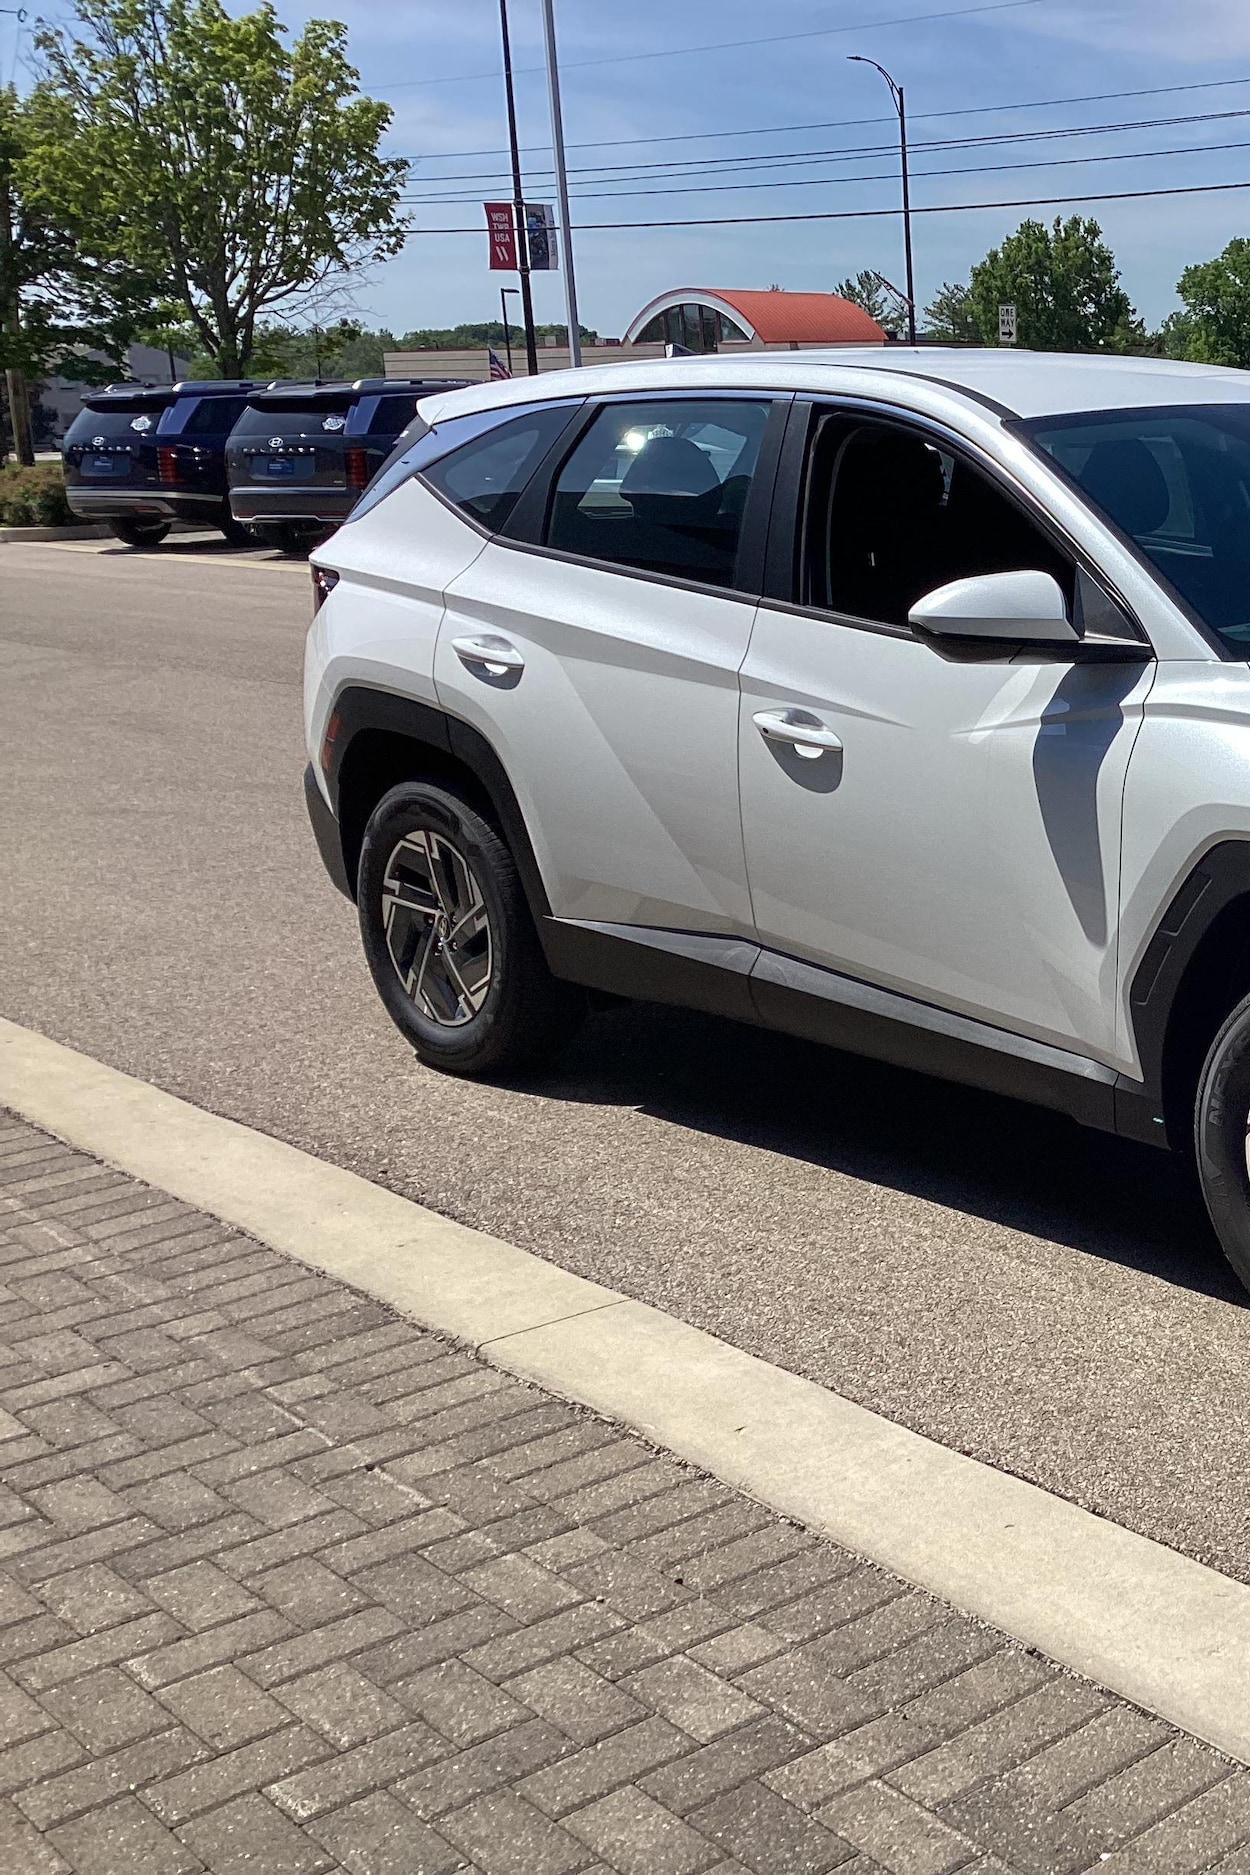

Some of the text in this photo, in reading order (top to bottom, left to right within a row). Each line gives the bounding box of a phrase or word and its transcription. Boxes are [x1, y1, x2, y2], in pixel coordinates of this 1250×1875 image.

[491, 212, 509, 222] WSH
[494, 233, 511, 243] USA
[1000, 308, 1014, 317] ONE
[1000, 318, 1014, 328] WAY
